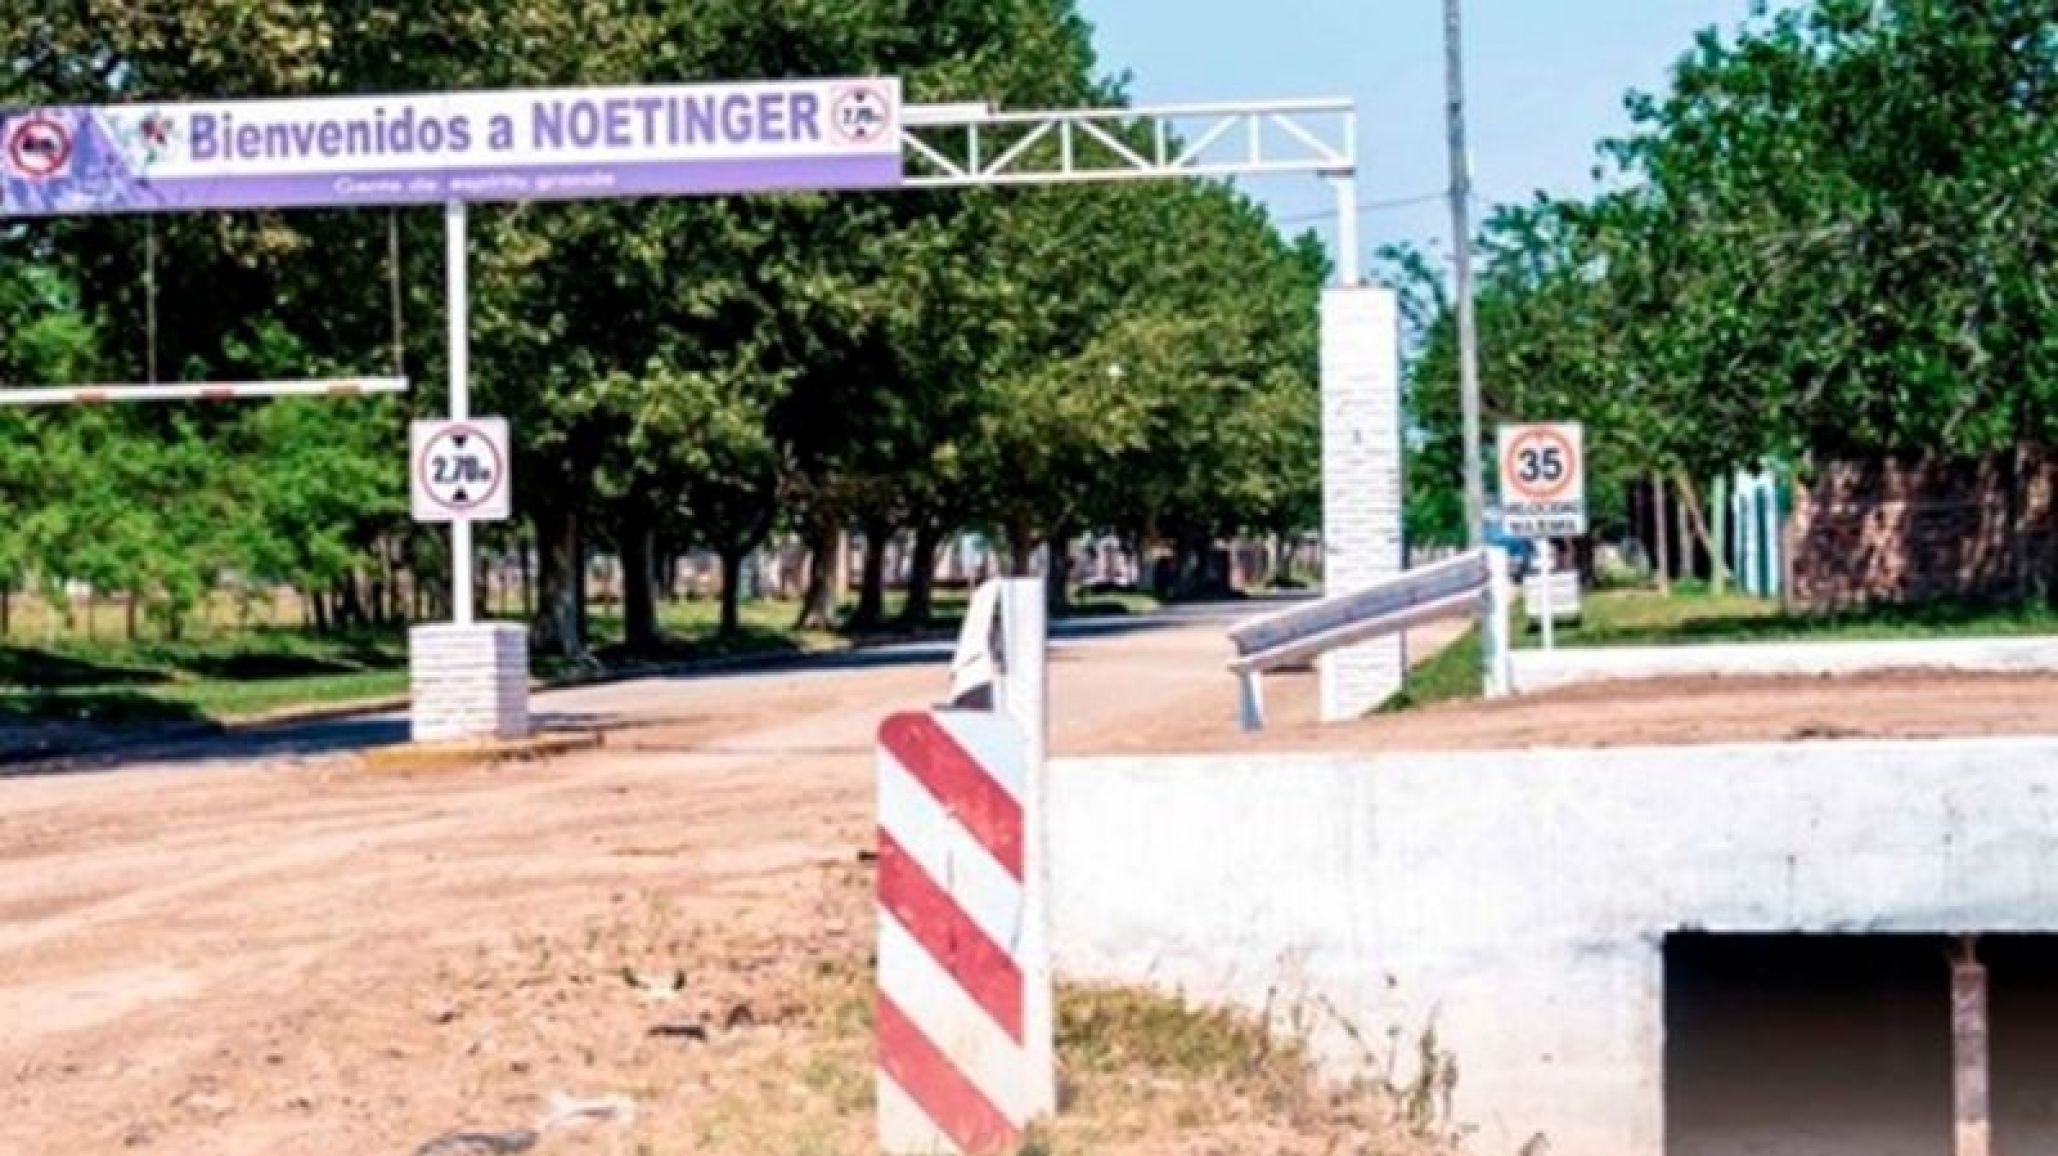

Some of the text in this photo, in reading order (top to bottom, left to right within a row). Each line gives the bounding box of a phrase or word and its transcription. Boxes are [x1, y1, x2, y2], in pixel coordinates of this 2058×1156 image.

[189, 91, 820, 161] Bienvenidos a NOETINGER
[334, 176, 401, 193] Gente
[408, 175, 438, 192] de
[1519, 447, 1562, 482] 35
